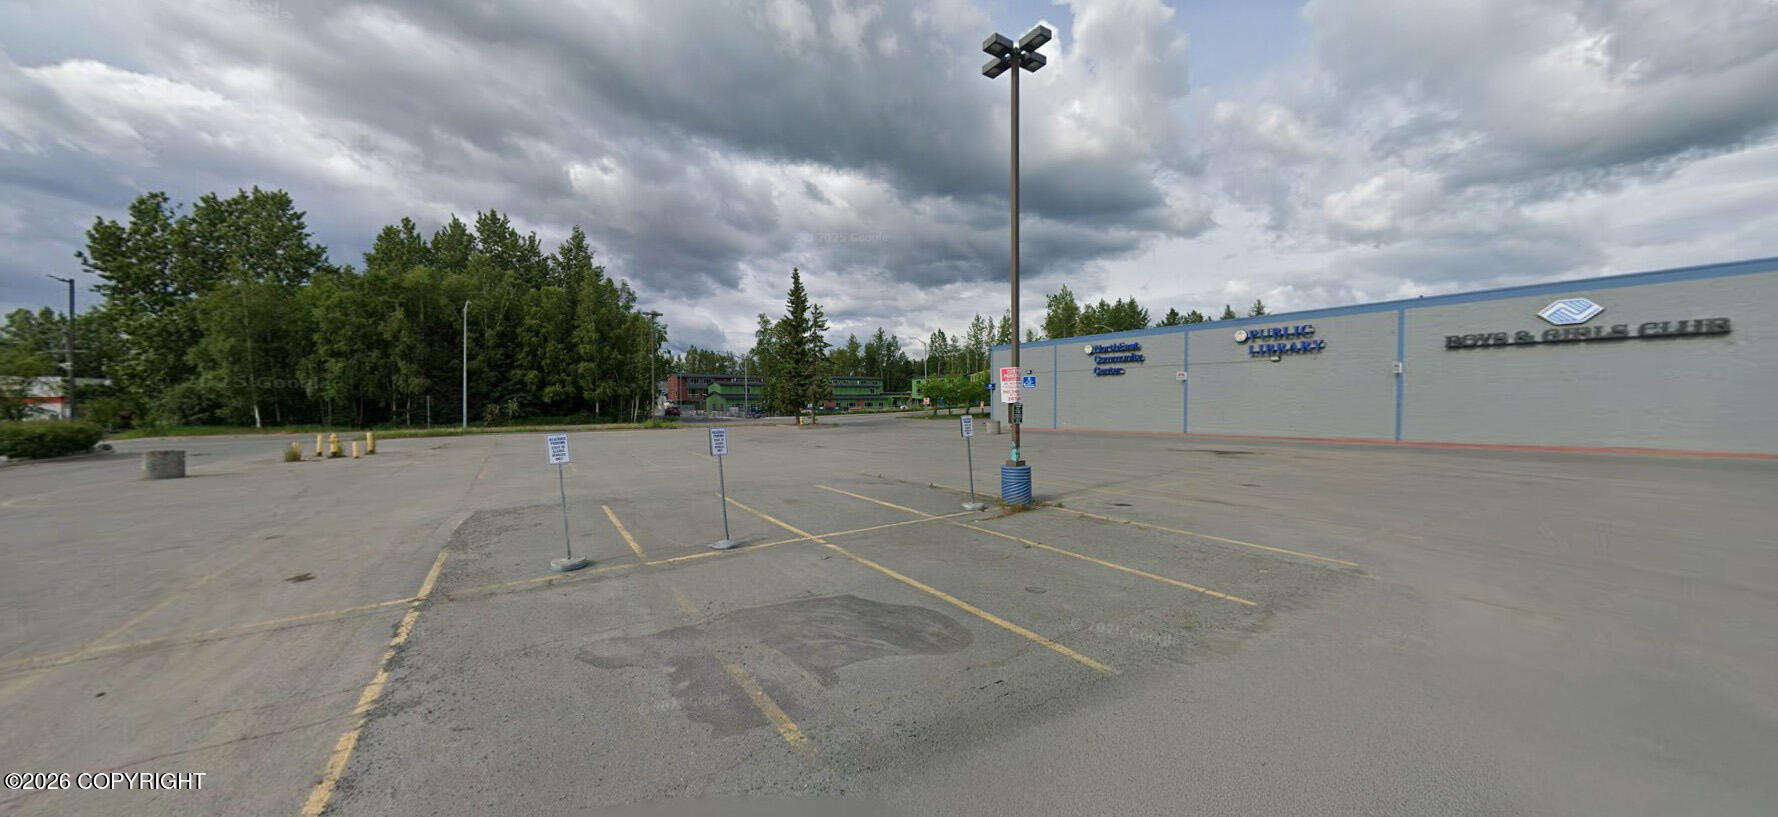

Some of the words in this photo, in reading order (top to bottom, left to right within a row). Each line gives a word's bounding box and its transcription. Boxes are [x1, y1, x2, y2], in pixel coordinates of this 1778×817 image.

[1248, 324, 1315, 339] PUBLIC
[1445, 332, 1508, 350] BOYS
[1514, 330, 1536, 347] &
[1541, 322, 1628, 345] GIRLS
[1638, 317, 1731, 341] CLUB
[1248, 340, 1326, 356] LIBRARY
